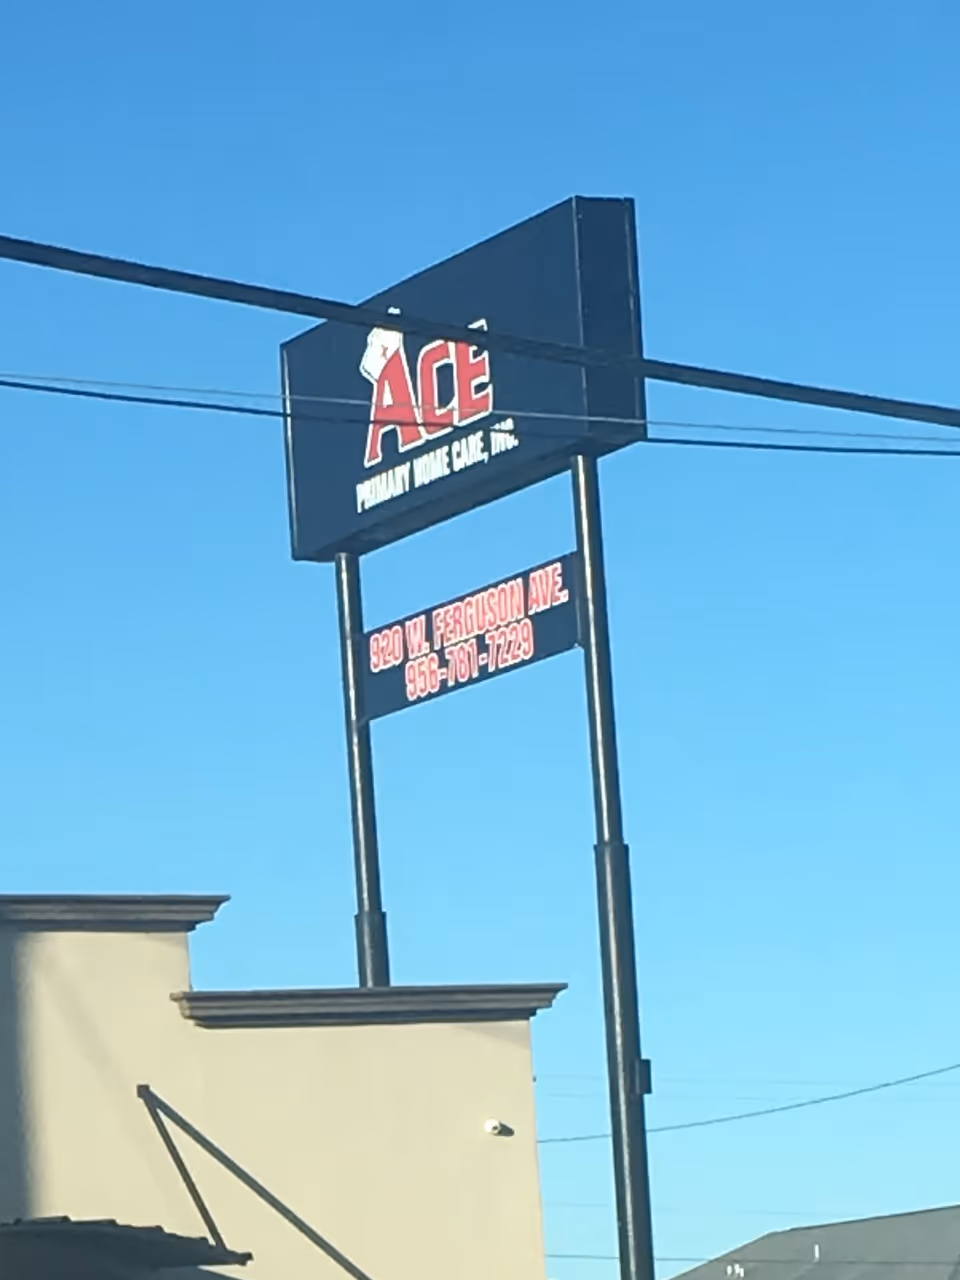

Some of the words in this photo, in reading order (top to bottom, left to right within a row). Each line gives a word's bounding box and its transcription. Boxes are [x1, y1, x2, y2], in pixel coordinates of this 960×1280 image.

[360, 307, 493, 468] ACE
[356, 461, 411, 514] PRIMARY
[413, 445, 451, 488] HOME
[451, 430, 489, 473] CARE,
[369, 625, 404, 673] 920
[405, 614, 430, 660] W.
[432, 578, 526, 650] FERGUSON
[528, 562, 569, 616] AVE.
[404, 618, 535, 701] 956-781-7229
